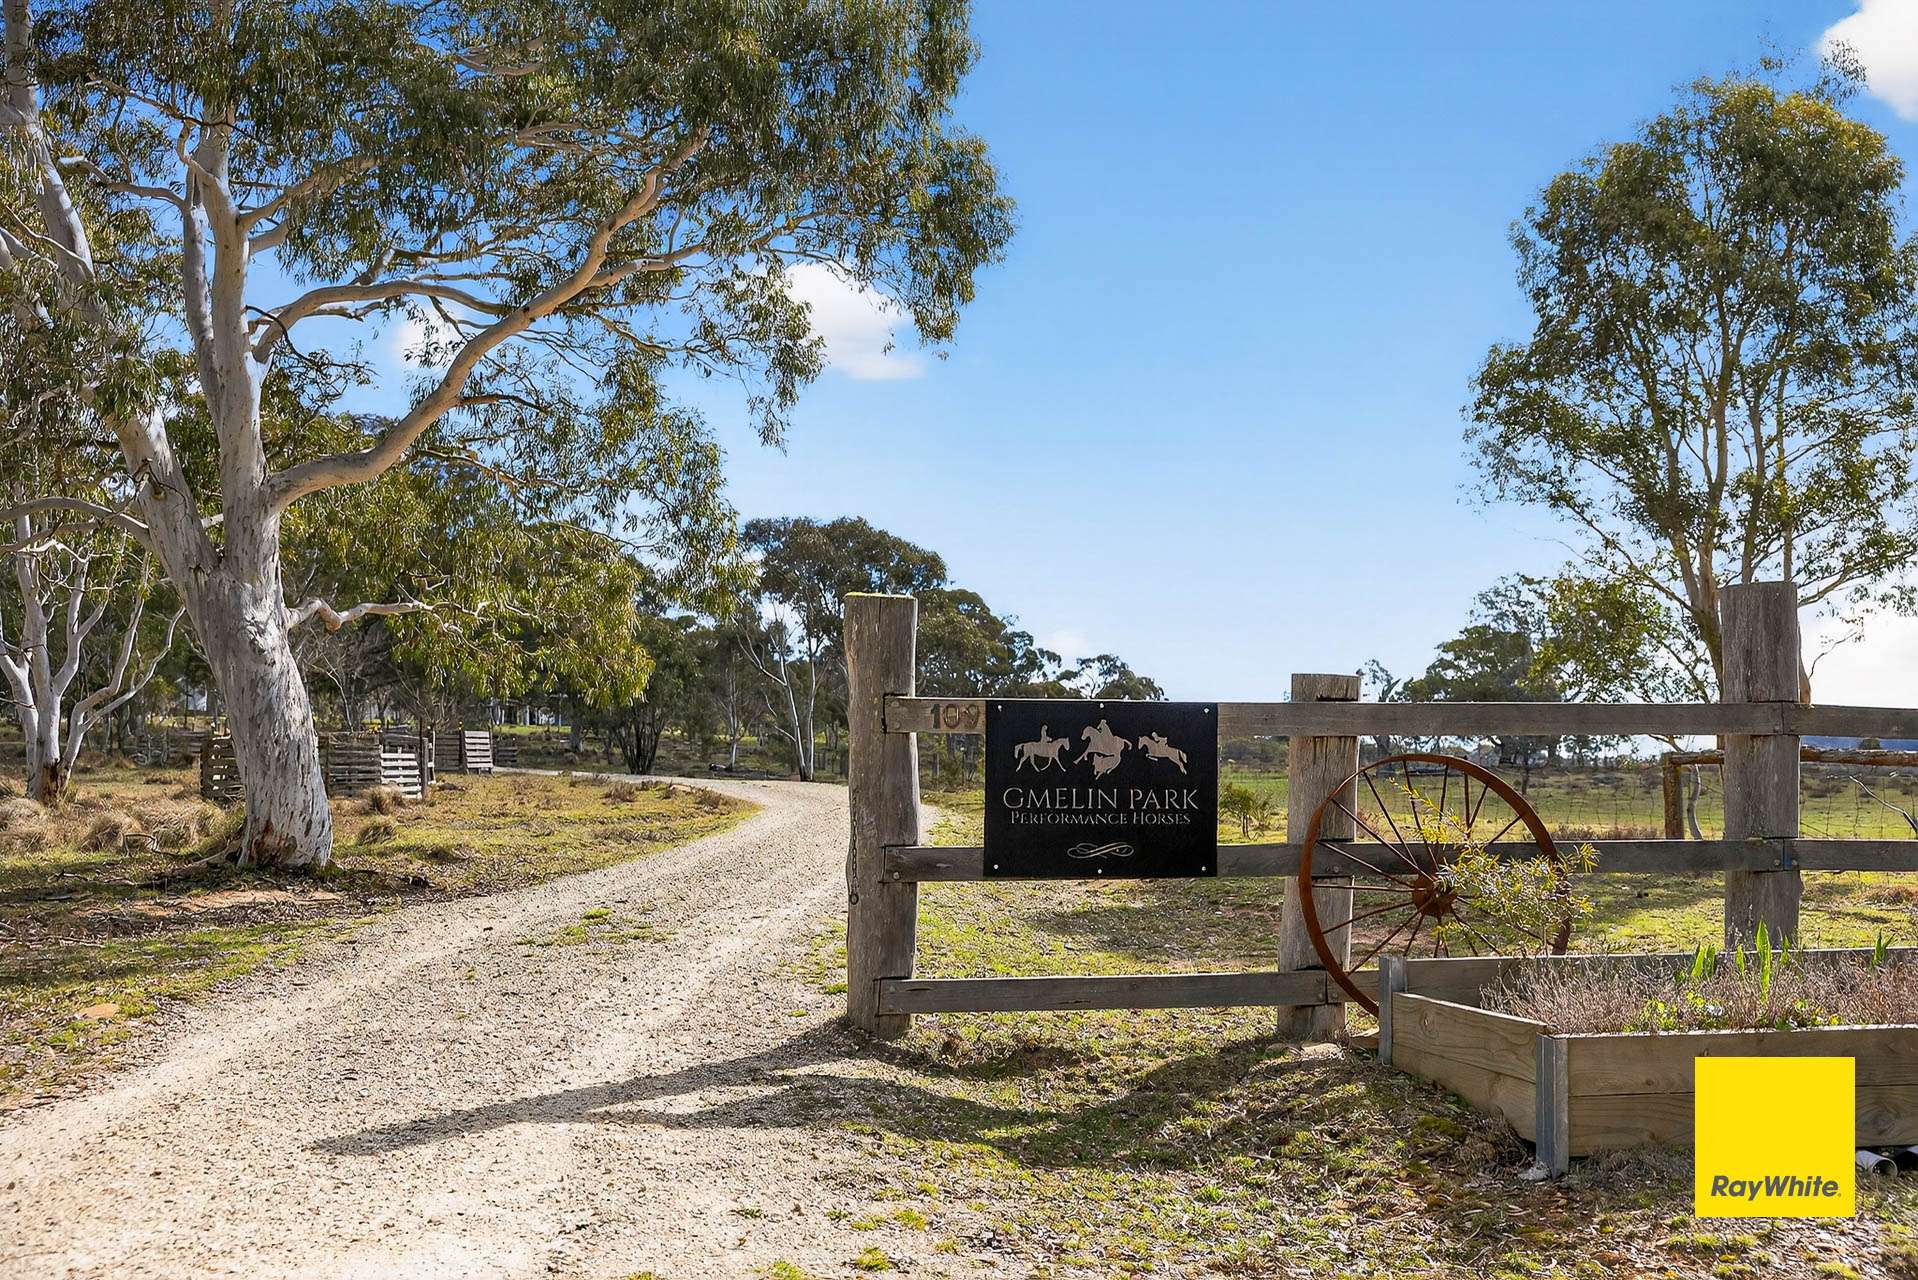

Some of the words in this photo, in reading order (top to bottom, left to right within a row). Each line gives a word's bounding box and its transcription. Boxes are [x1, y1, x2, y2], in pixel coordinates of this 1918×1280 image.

[930, 703, 980, 729] 109
[1003, 787, 1117, 809] GMELIN
[1128, 788, 1199, 809] PARK
[1010, 811, 1127, 825] PERFORMANCE
[1132, 811, 1191, 825] HORSES
